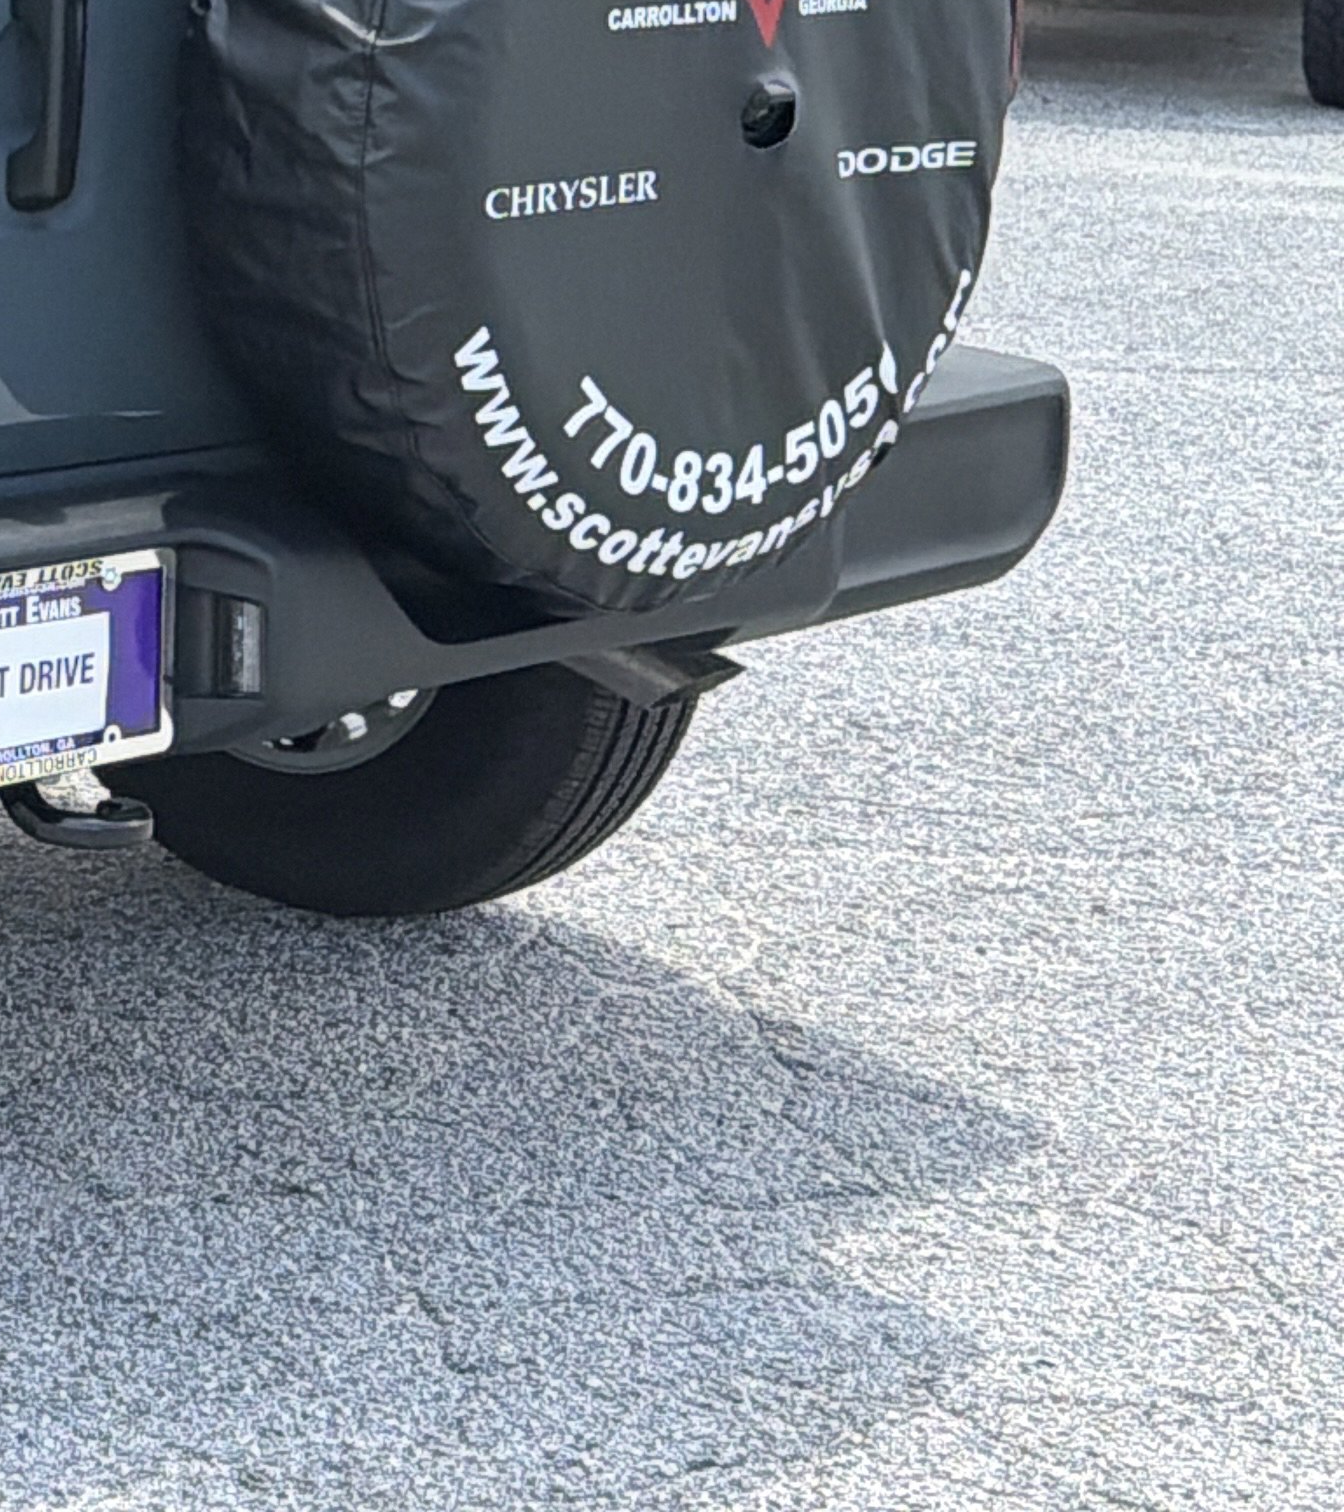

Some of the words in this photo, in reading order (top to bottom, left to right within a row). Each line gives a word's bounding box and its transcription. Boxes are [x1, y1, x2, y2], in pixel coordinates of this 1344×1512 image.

[607, 0, 737, 31] CARROLLTON
[837, 141, 977, 179] DODGE
[485, 170, 658, 219] CHRYSLER
[26, 595, 82, 624] EVANS
[19, 652, 95, 695] DRIVE
